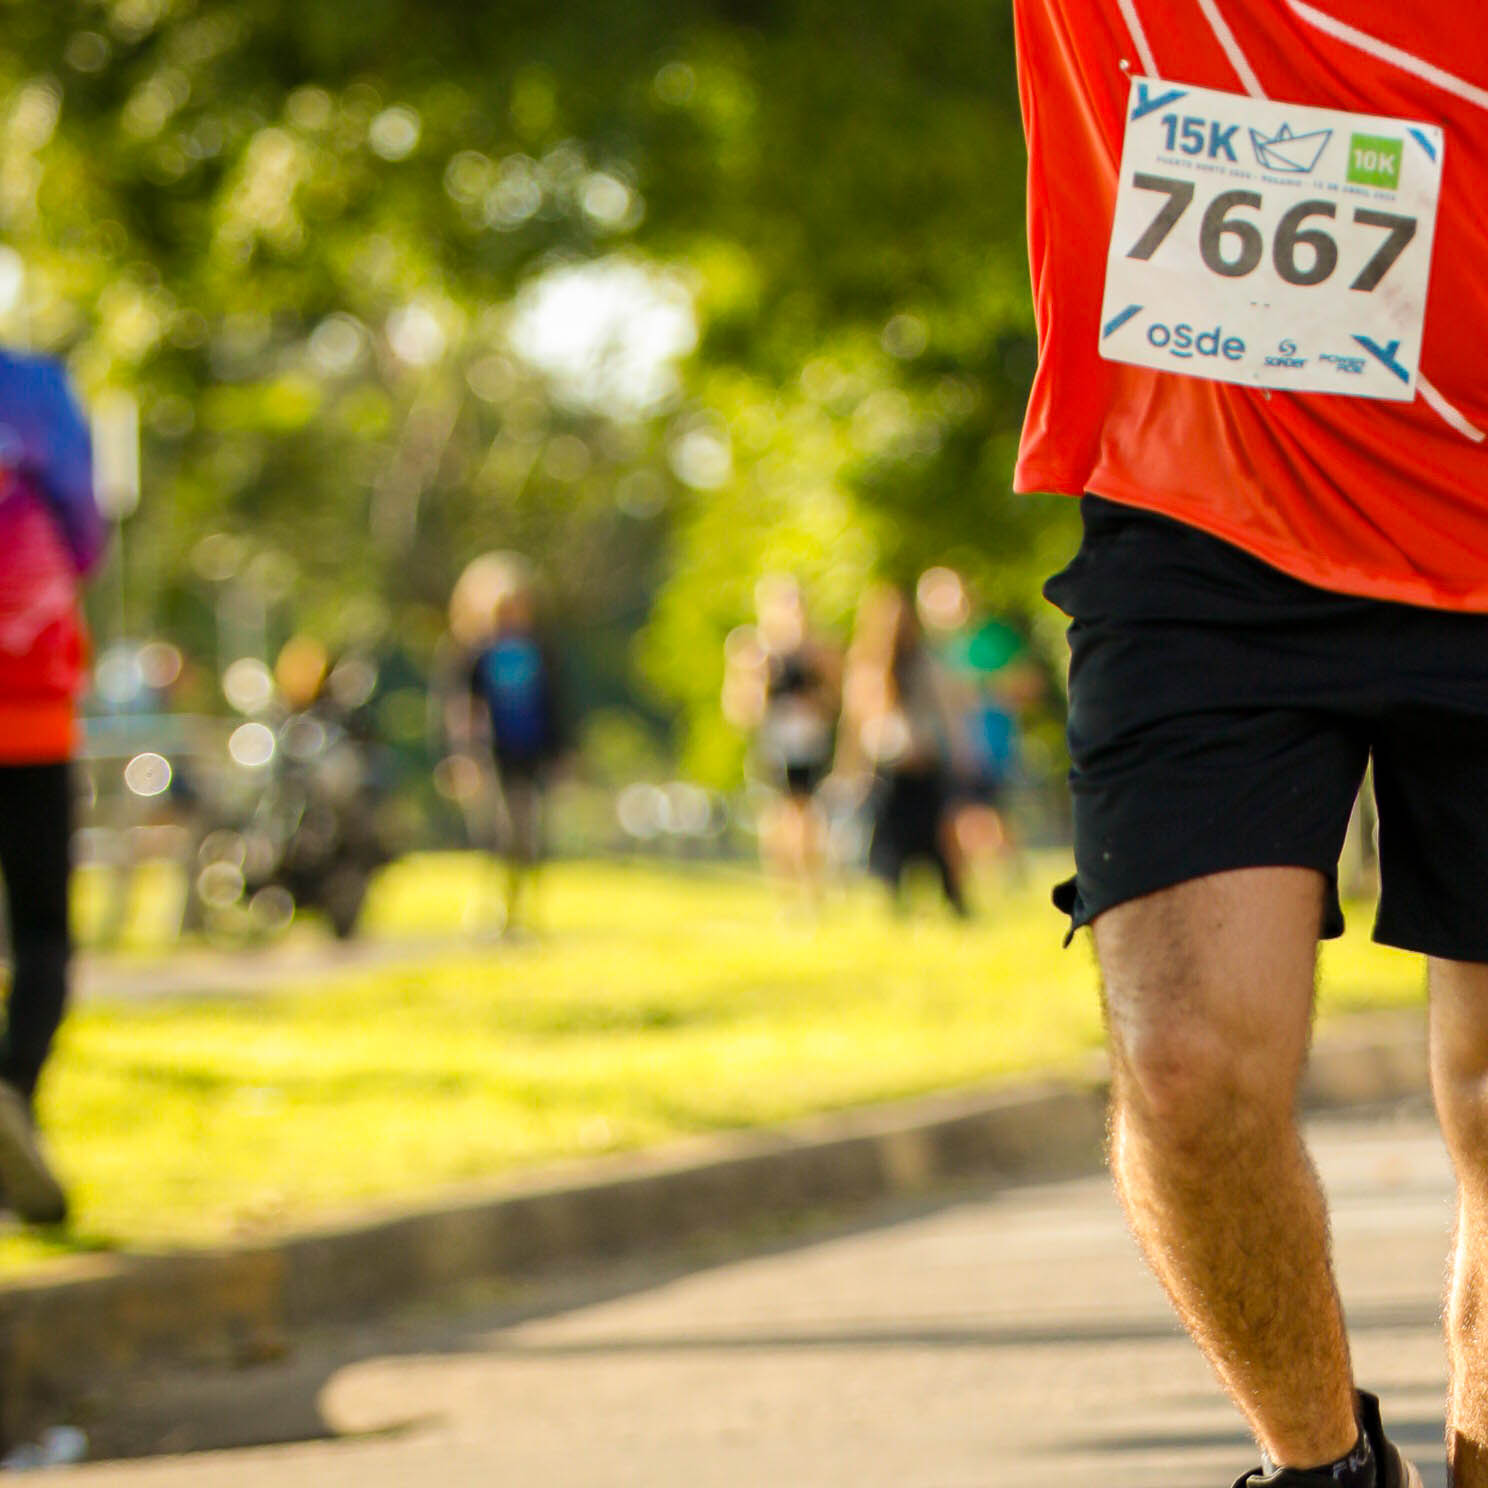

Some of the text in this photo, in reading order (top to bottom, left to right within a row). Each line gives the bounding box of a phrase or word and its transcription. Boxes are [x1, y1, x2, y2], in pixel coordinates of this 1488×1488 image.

[1160, 113, 1241, 163] 15K
[1352, 148, 1396, 175] 10K
[1126, 171, 1418, 293] 7667
[1147, 322, 1246, 361] osde
